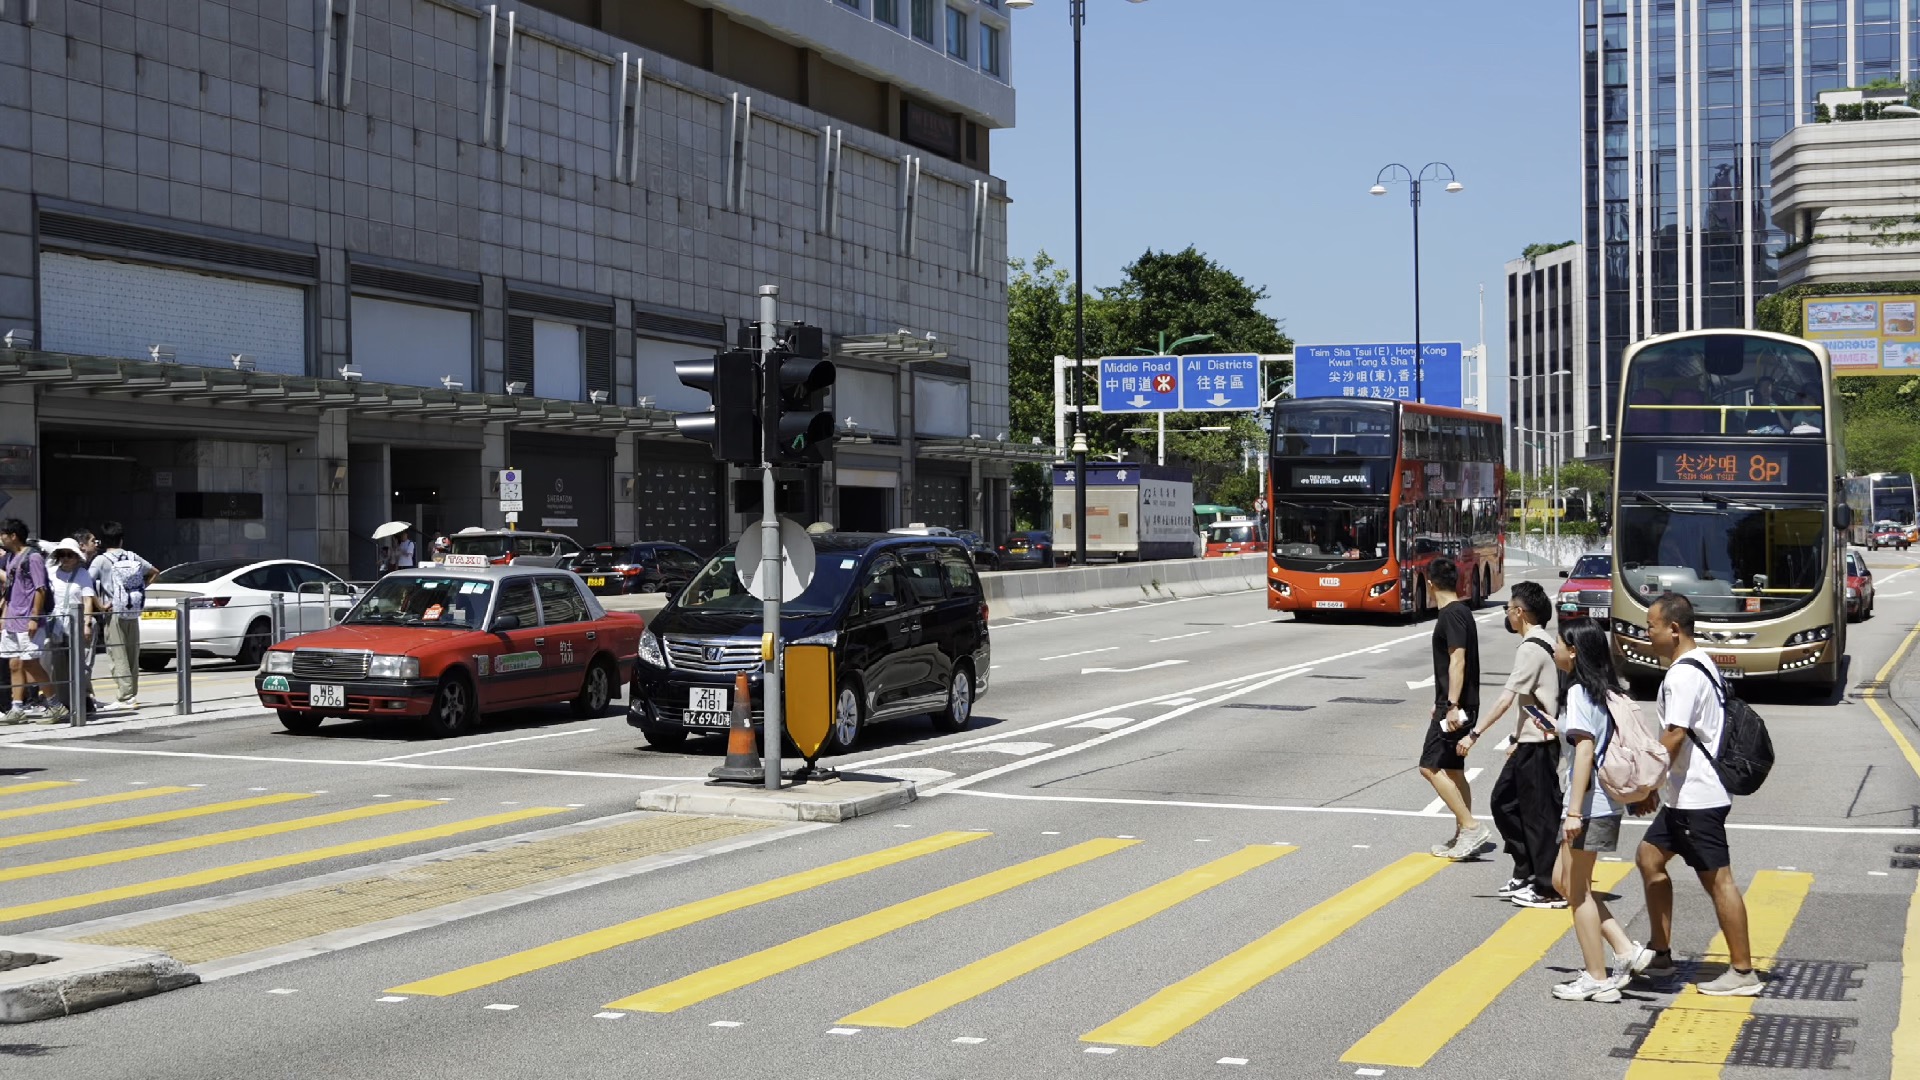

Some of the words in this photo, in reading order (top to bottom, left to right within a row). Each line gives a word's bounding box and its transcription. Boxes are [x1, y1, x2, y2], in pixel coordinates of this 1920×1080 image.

[1310, 348, 1330, 357] Tsim
[1334, 348, 1350, 356] Sha
[1354, 348, 1372, 357] Tsui
[1422, 346, 1447, 357] Kong
[1105, 362, 1139, 373] Middle
[1142, 361, 1171, 372] Road
[1187, 360, 1201, 371] All
[1207, 359, 1253, 370] Districts
[1329, 358, 1354, 367] Kwun
[1356, 357, 1378, 368] Tong
[1380, 358, 1388, 366] &
[1390, 357, 1408, 366] Sha
[1411, 356, 1425, 365] Tn
[1105, 376, 1152, 392] 中間道
[1197, 374, 1244, 390] 往各區
[1675, 453, 1739, 474] 尖沙咀
[1749, 454, 1780, 481] 8P
[546, 494, 573, 503] SHERATON
[448, 555, 482, 565] TAXI
[559, 640, 573, 651] 的士
[560, 652, 574, 665] TAXI
[1711, 654, 1737, 665] KMB
[320, 685, 334, 696] WB
[701, 688, 716, 700] ZH
[312, 695, 342, 706] 9706
[696, 699, 720, 710] 4181
